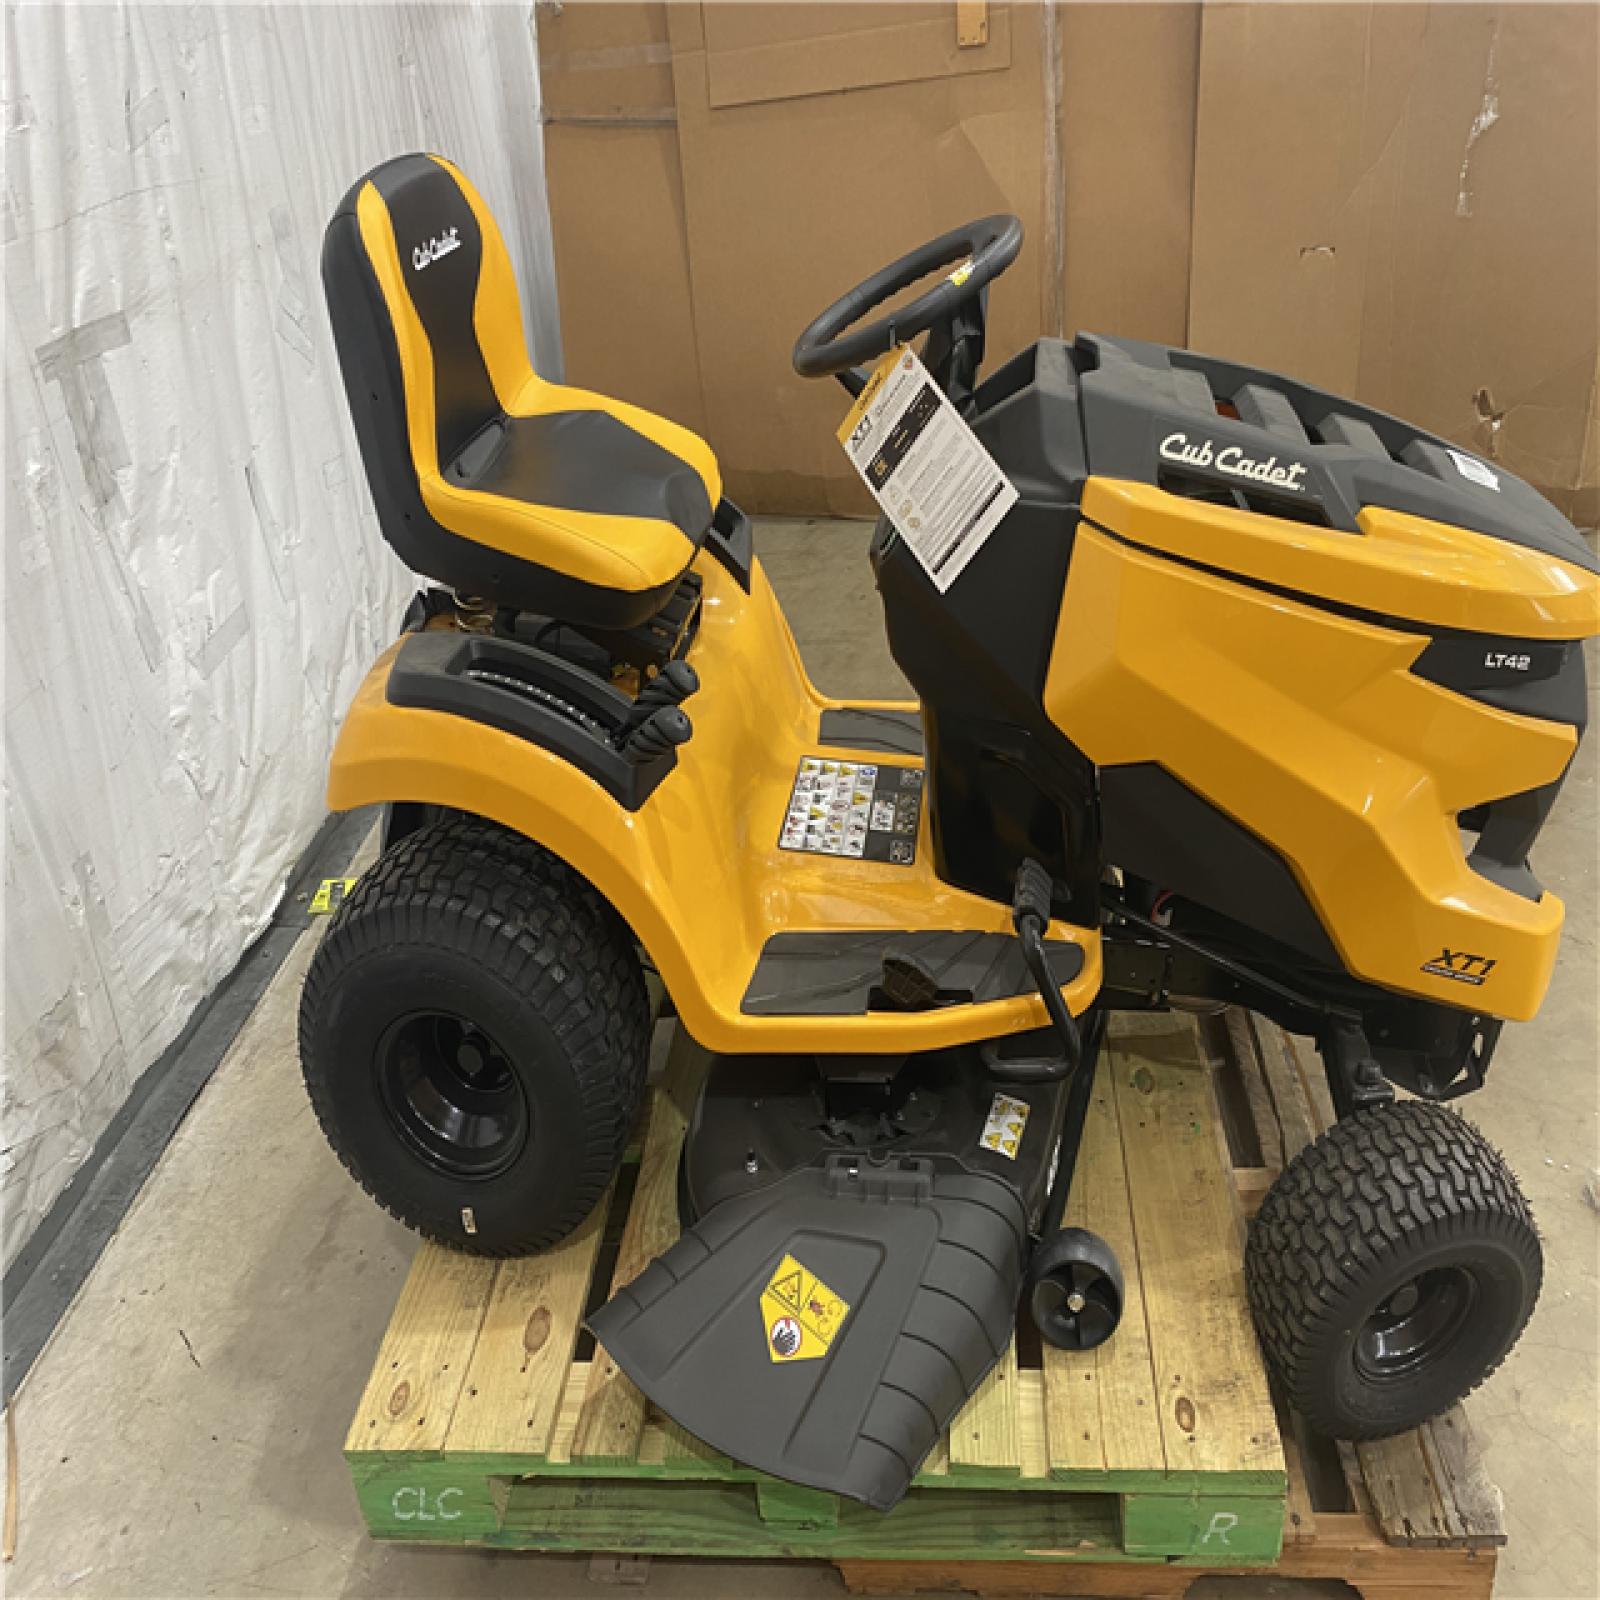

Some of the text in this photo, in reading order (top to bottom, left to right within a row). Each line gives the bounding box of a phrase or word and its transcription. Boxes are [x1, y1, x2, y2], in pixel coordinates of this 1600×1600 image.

[1159, 432, 1308, 492] Cub Cadet
[1484, 652, 1531, 671] LT42
[1428, 948, 1497, 977] XT1
[391, 1487, 464, 1521] CLC
[1201, 1511, 1239, 1546] R
